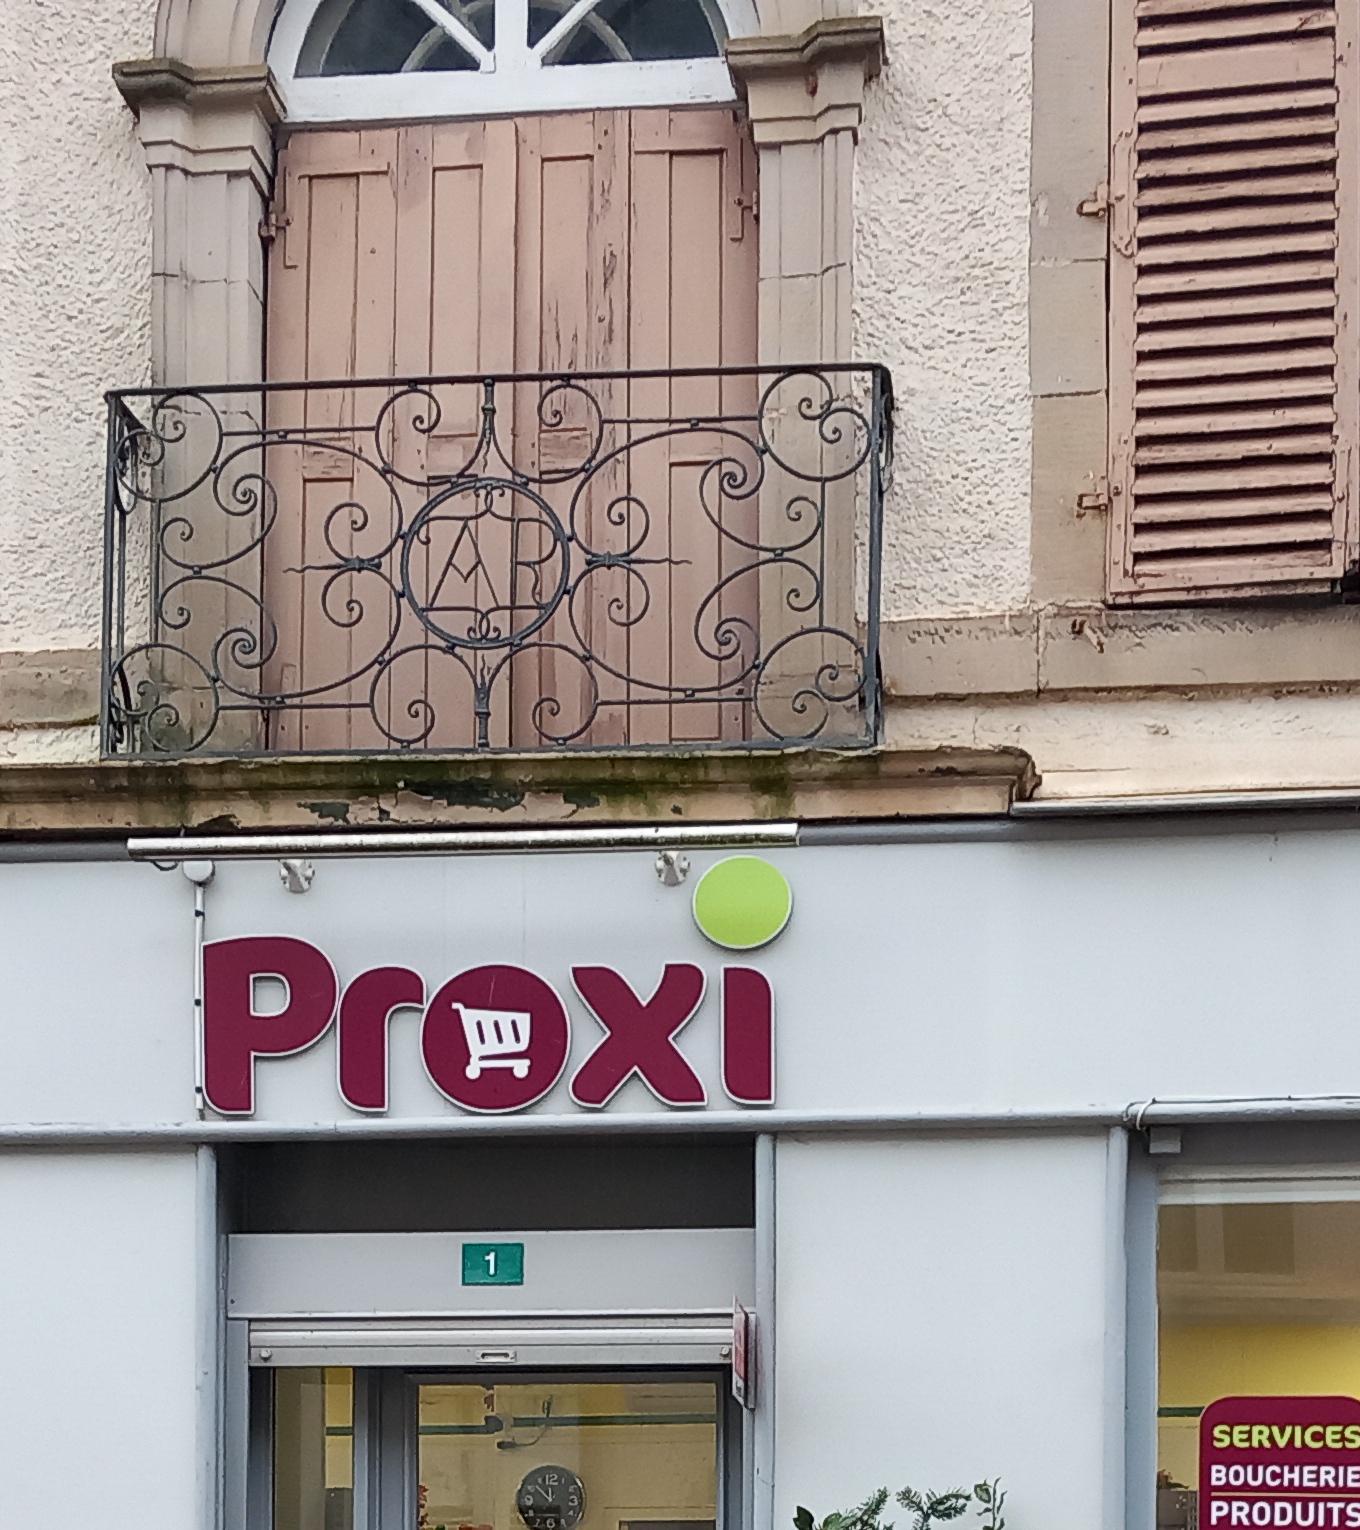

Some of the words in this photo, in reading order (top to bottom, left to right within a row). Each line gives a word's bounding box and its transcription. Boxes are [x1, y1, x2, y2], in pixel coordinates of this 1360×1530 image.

[202, 855, 793, 1116] Proxi
[484, 1251, 496, 1276] 1
[545, 1474, 558, 1485] 12
[568, 1495, 578, 1506] 3
